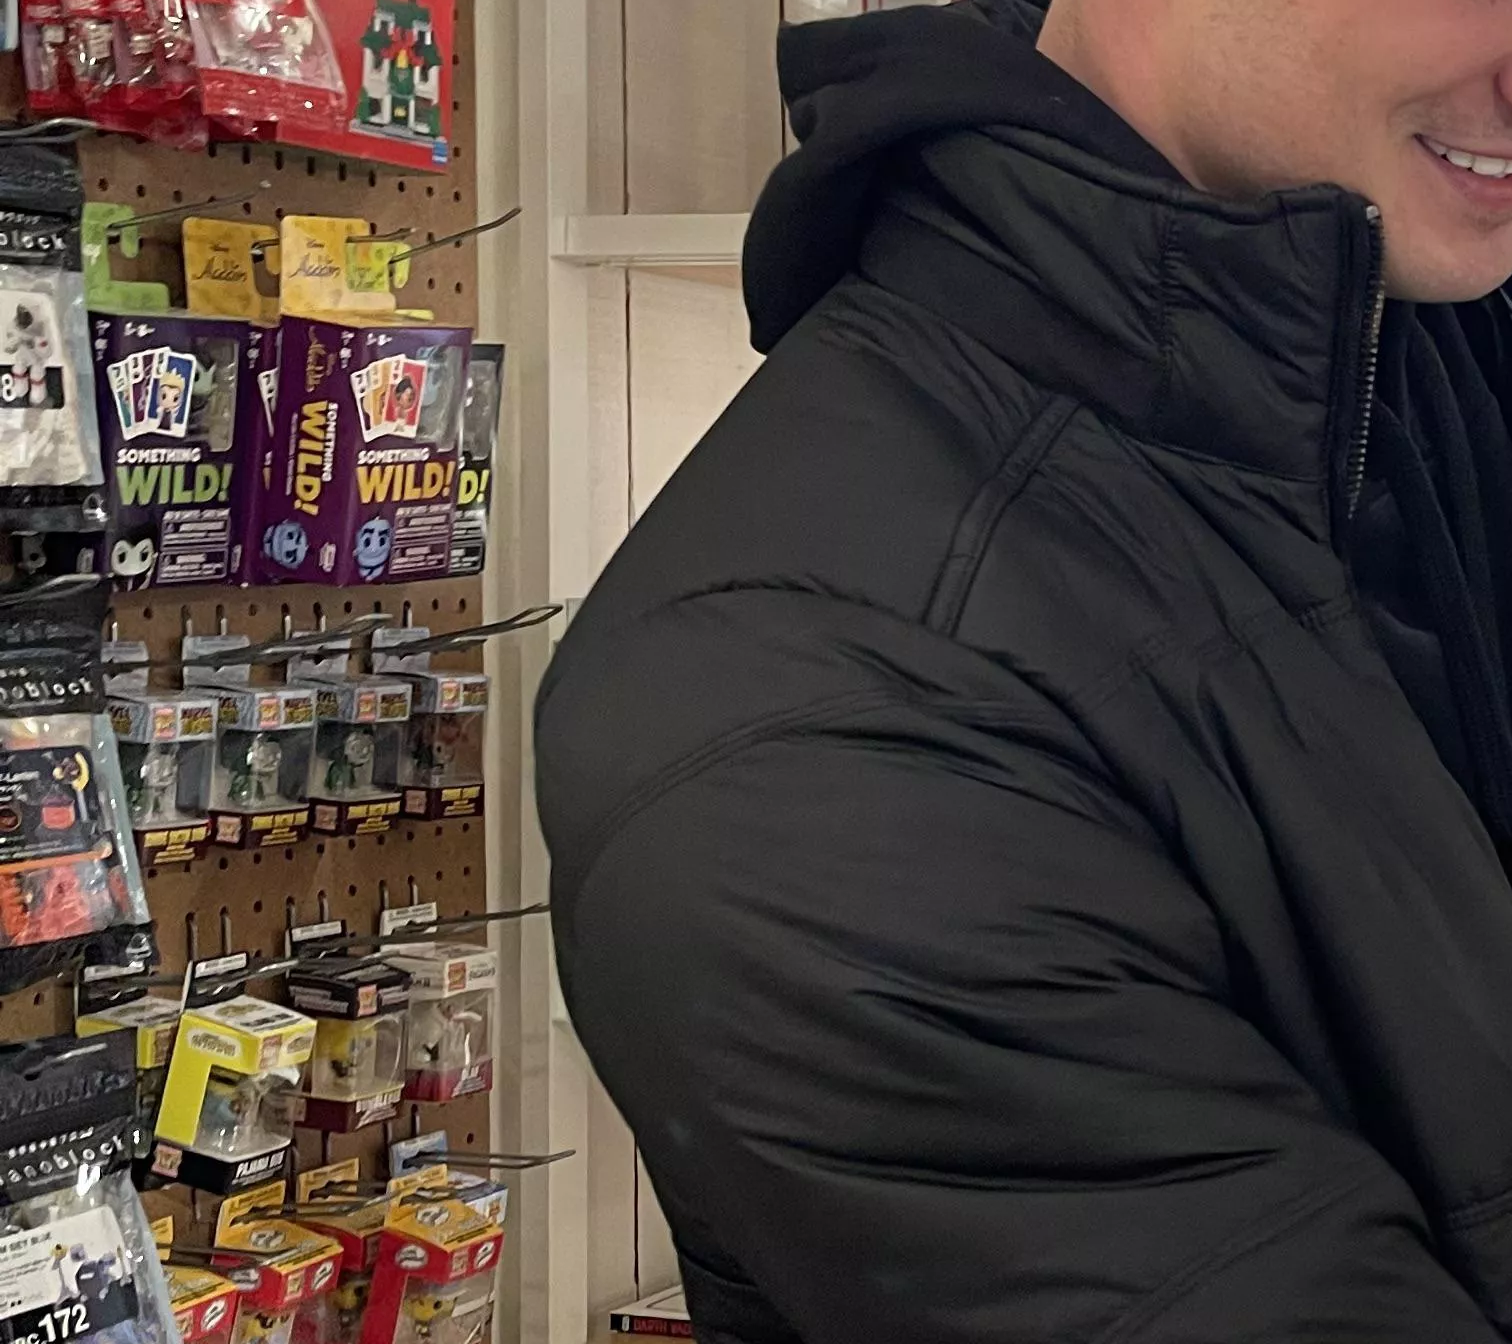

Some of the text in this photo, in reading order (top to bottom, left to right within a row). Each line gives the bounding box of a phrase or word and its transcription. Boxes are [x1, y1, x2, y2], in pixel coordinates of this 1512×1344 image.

[117, 447, 201, 464] SOMETHING
[294, 401, 328, 516] WILD!
[357, 447, 430, 465] SOMETHING
[116, 463, 233, 506] WILD!
[356, 461, 458, 504] WILD!
